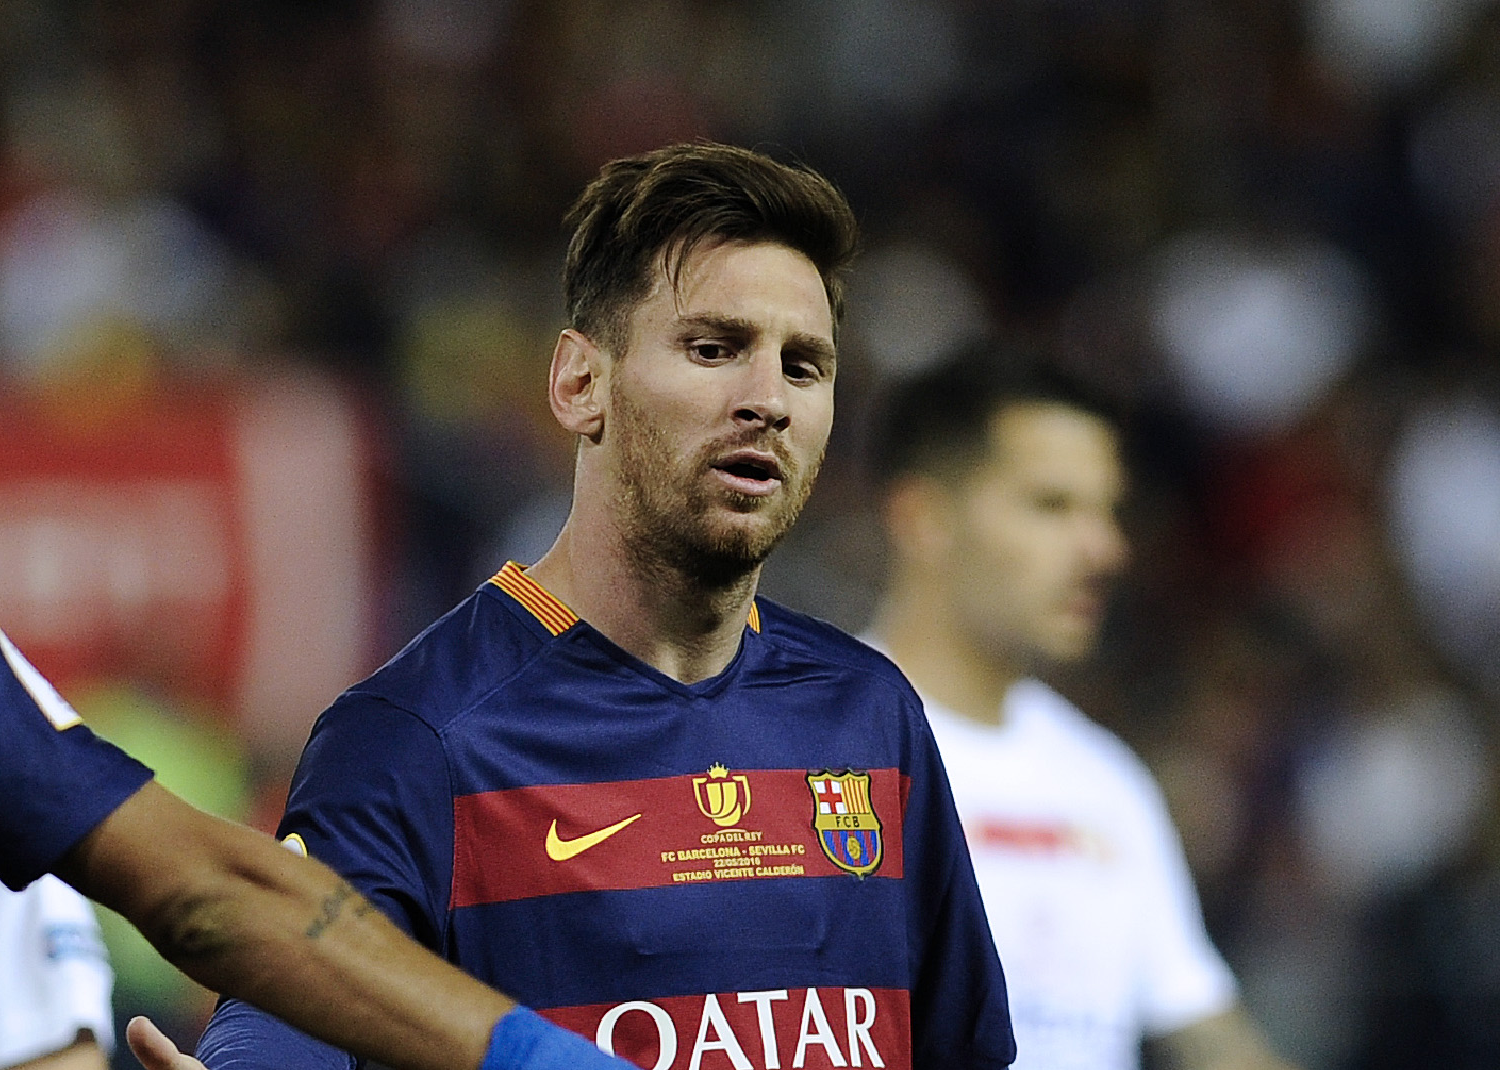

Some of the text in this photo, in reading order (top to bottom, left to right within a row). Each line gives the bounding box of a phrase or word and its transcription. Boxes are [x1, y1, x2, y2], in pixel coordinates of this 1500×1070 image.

[835, 815, 860, 828] FCB
[660, 851, 676, 862] FC
[677, 847, 741, 861] BARCELONA
[748, 845, 790, 856] SEVILLA
[791, 844, 806, 855] FC
[714, 867, 755, 879] VICENTE
[755, 863, 805, 877] CALDERÓN
